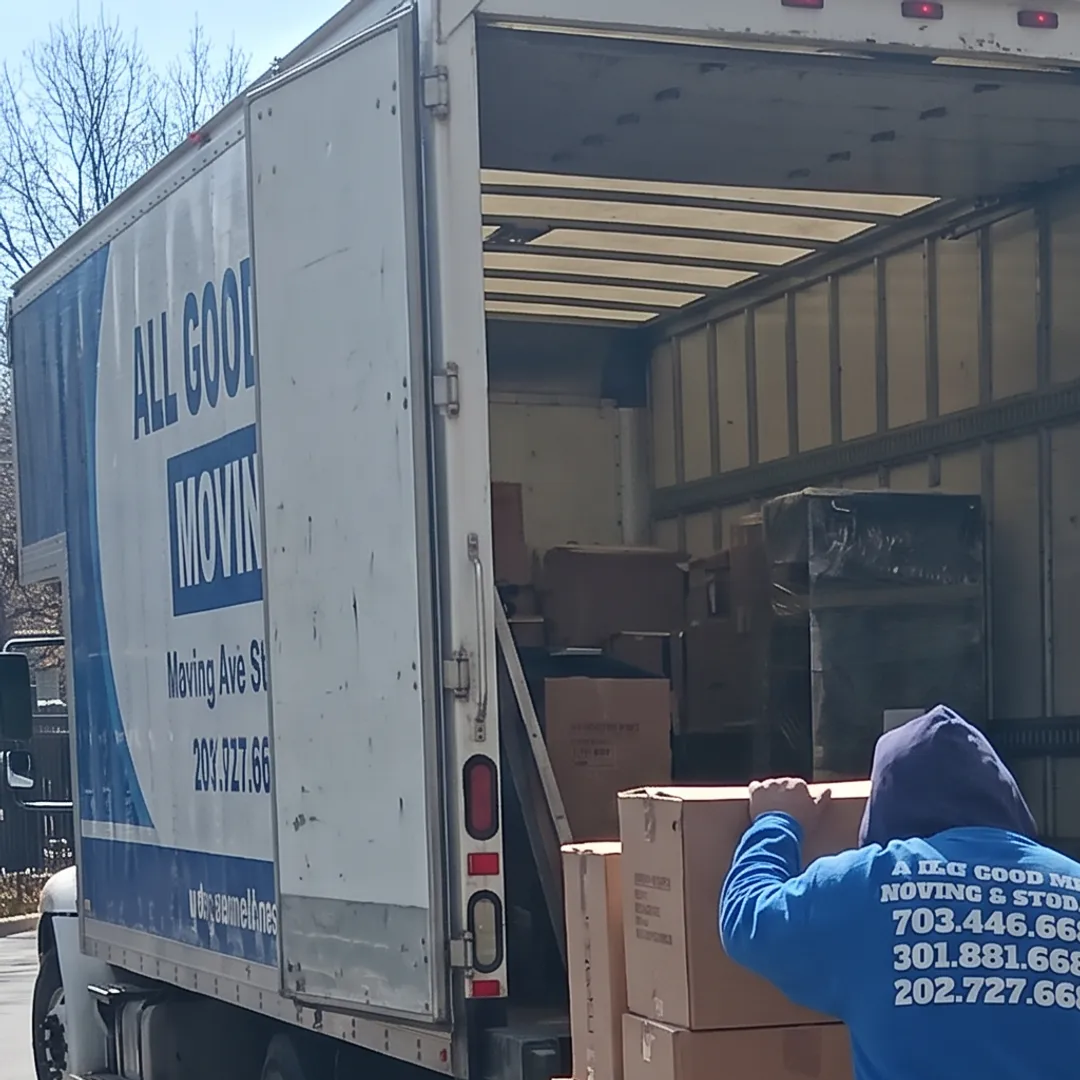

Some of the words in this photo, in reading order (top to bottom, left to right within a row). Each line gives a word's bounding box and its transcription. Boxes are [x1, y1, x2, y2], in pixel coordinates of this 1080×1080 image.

[133, 311, 179, 440] ALL
[175, 453, 263, 588] MOVIN
[974, 865, 1044, 885] GOOD
[988, 886, 1007, 905] &
